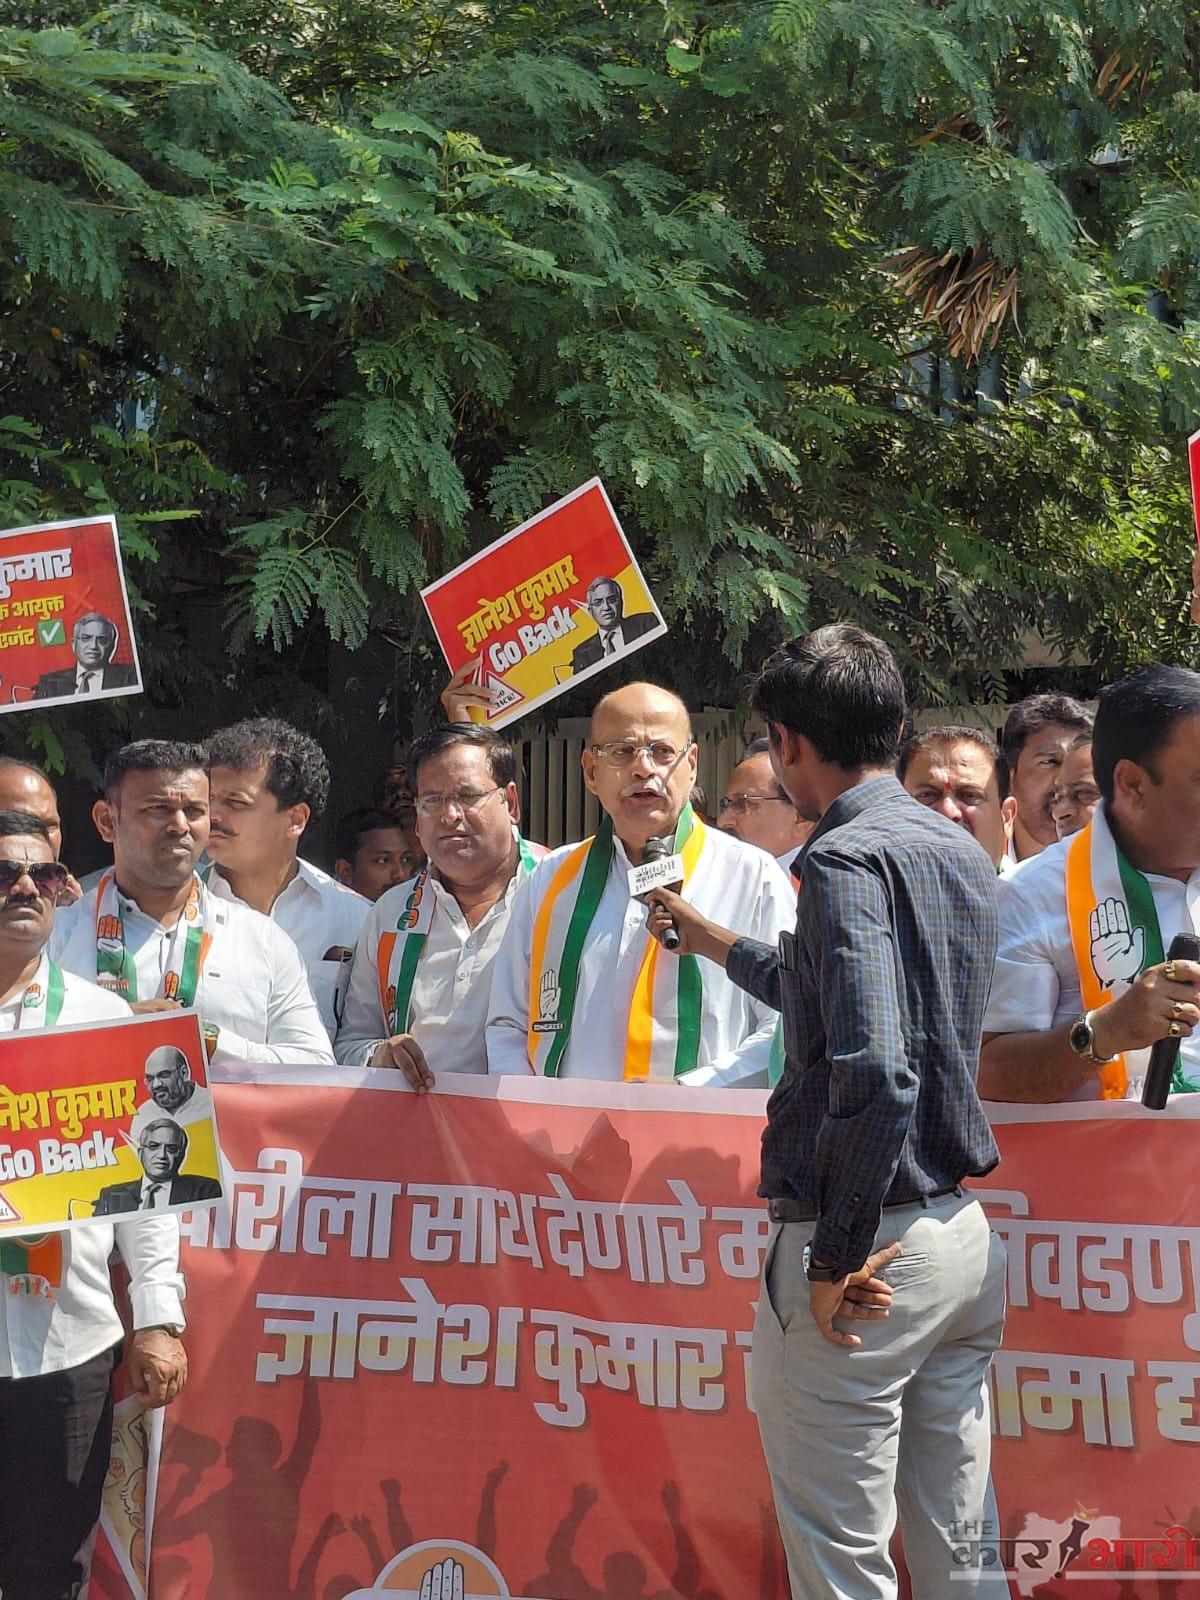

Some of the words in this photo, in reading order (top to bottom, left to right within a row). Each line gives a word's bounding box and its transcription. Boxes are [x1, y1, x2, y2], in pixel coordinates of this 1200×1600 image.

[457, 598, 521, 654] ज्ञानेश
[515, 554, 579, 620] कुमार
[488, 641, 521, 672] Go
[517, 605, 577, 656] Back
[51, 1080, 138, 1139] कुमार
[39, 1131, 119, 1175] Back
[407, 1184, 543, 1268] साथ
[540, 1173, 706, 1285] देणारे
[256, 1277, 524, 1387] ज्ञानेश
[530, 1308, 728, 1428] कुमार
